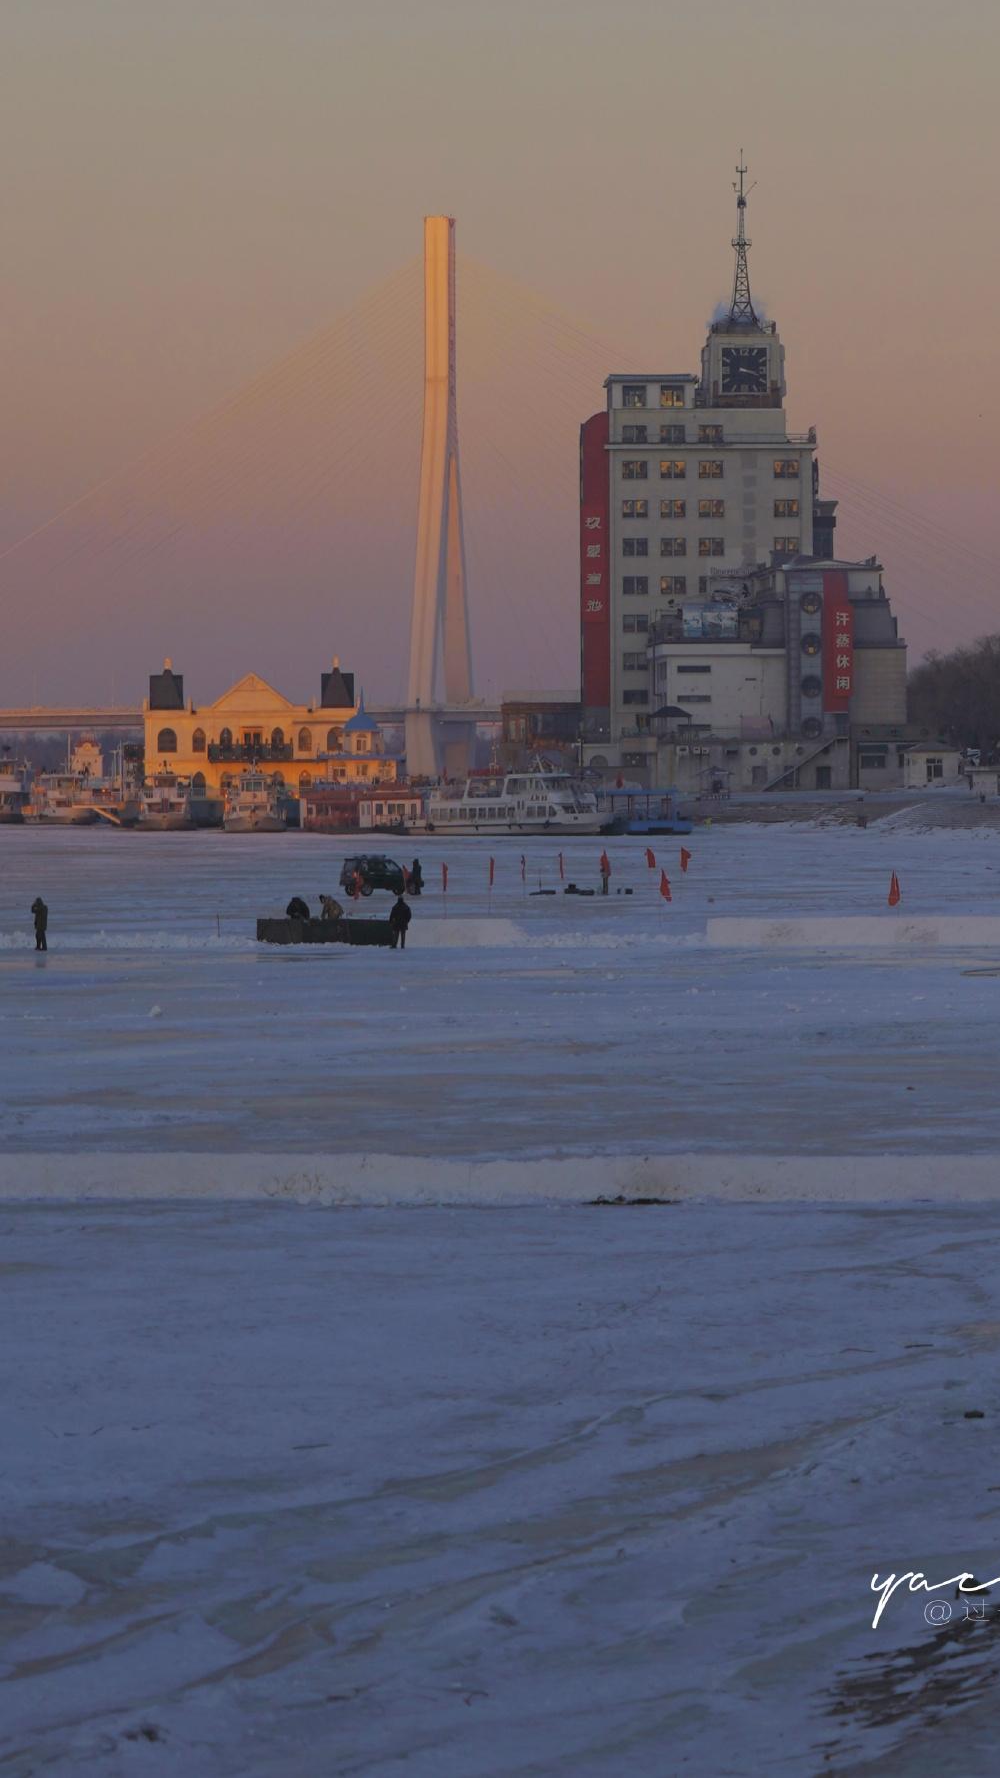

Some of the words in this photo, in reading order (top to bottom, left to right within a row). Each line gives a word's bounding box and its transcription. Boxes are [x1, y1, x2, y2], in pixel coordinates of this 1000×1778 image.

[740, 349, 749, 357] 12
[836, 612, 850, 690] 汗蒸休闲
